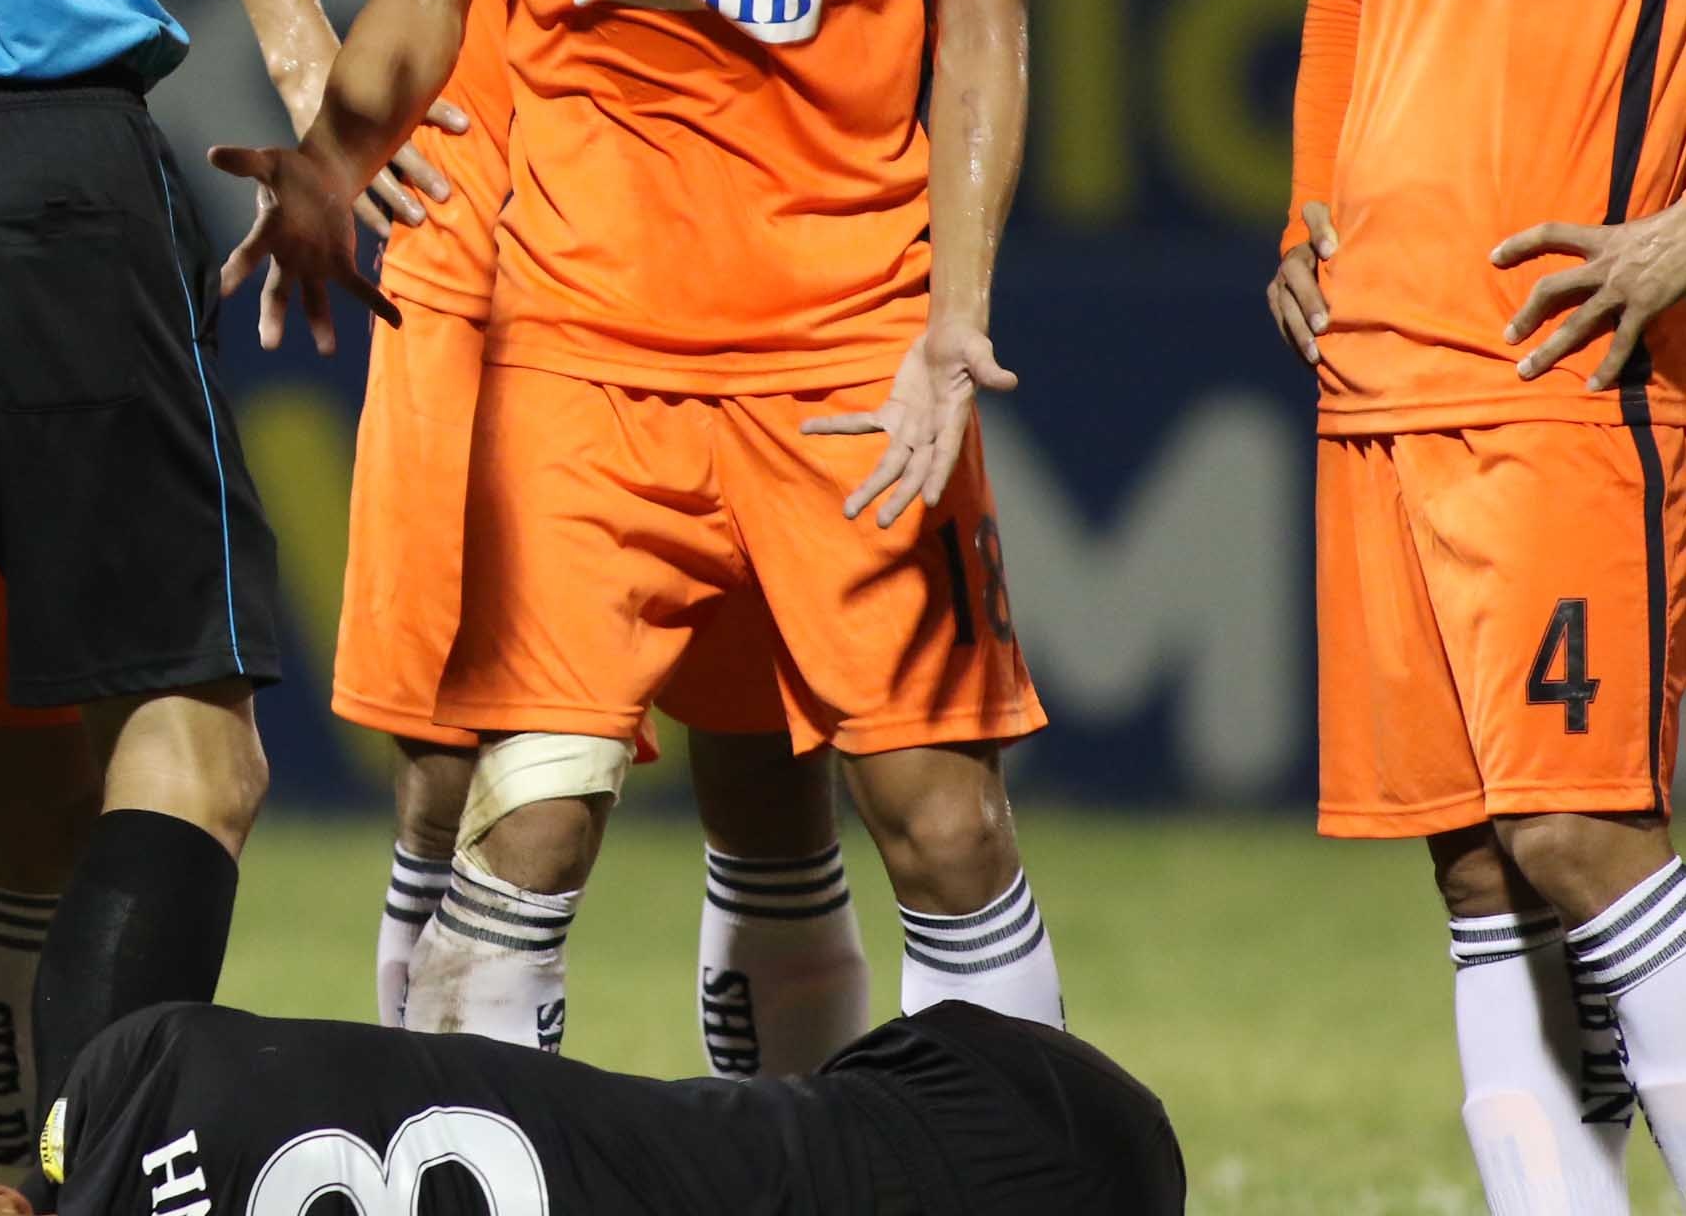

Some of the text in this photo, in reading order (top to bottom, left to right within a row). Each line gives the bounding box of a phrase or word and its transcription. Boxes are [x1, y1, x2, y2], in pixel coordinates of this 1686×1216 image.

[937, 514, 1013, 646] 18
[1525, 597, 1601, 735] 4
[701, 965, 762, 1077] SHB
